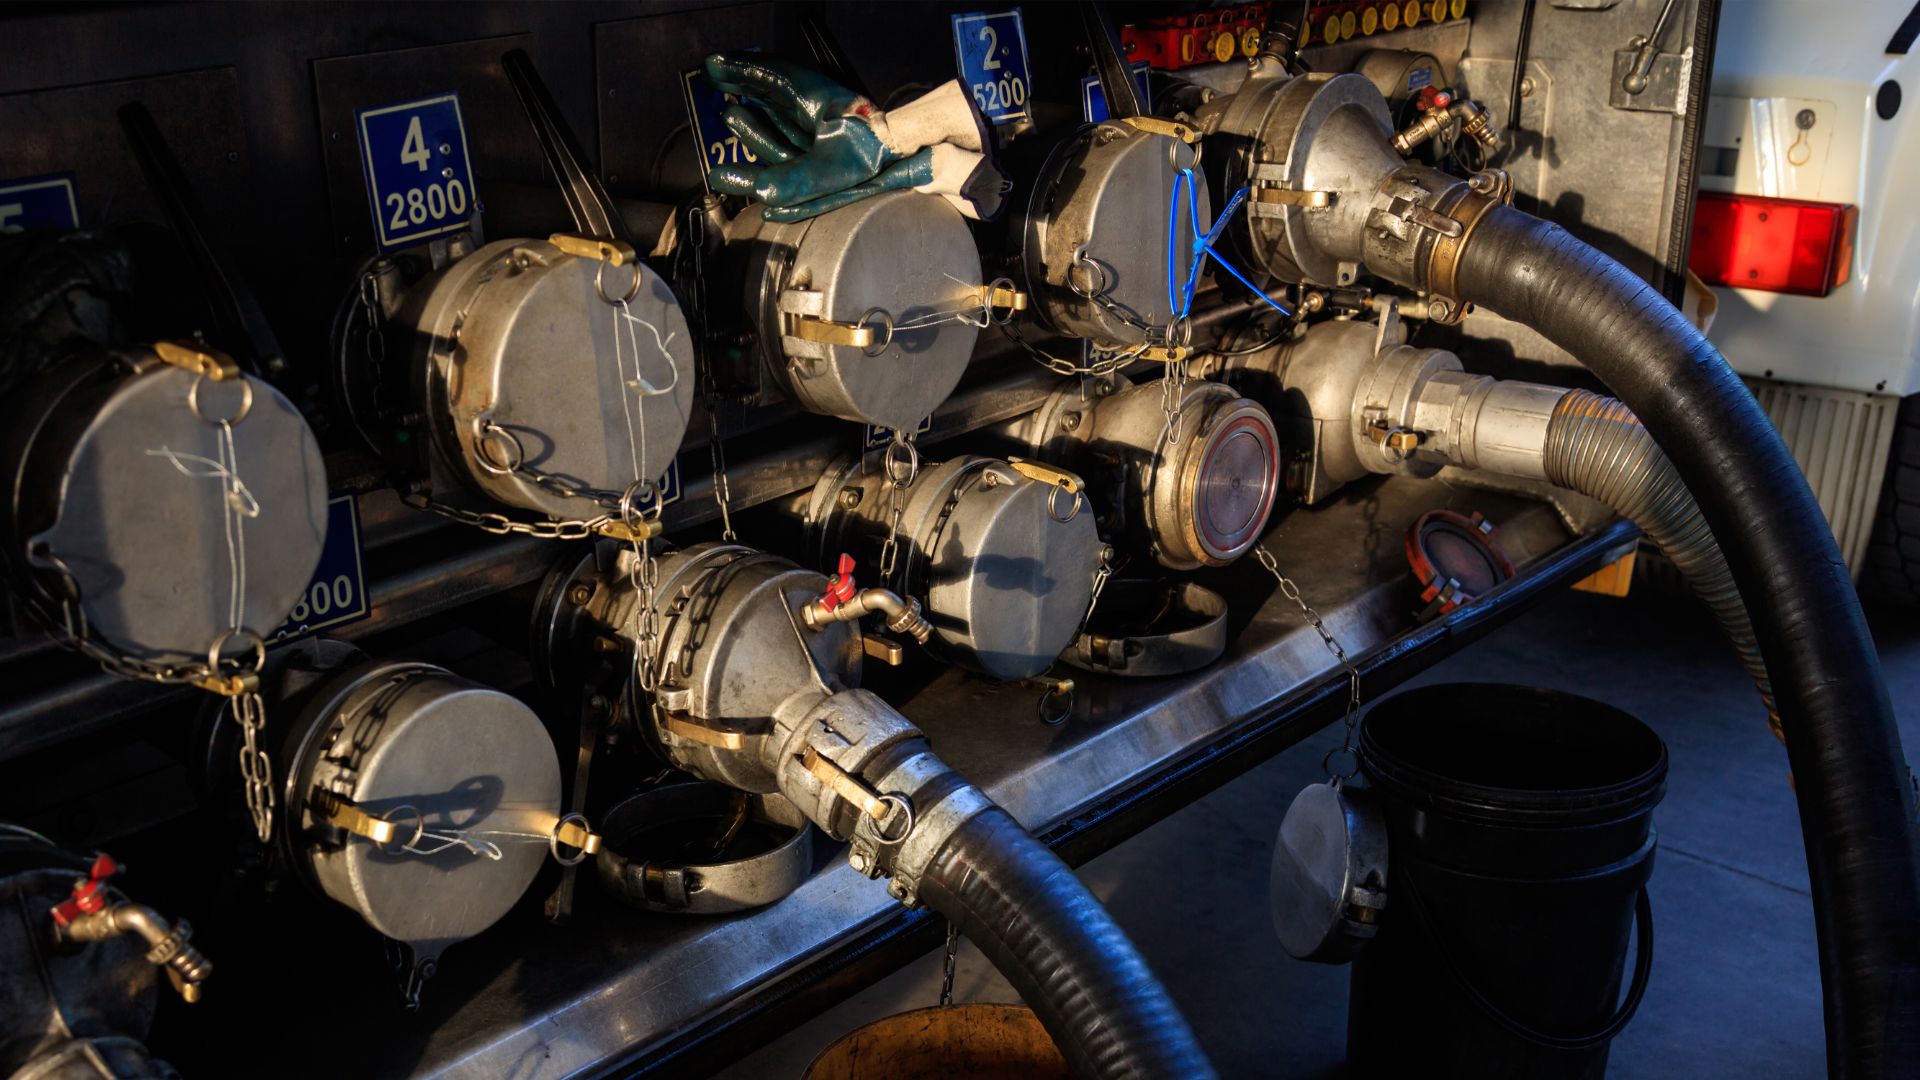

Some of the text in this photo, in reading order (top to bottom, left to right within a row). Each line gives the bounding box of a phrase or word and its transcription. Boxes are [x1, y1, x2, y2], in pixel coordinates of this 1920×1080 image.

[979, 26, 1001, 71] 2
[973, 77, 1025, 112] 5200
[400, 116, 431, 172] 4
[386, 179, 466, 230] 2800
[279, 575, 352, 626] 800
